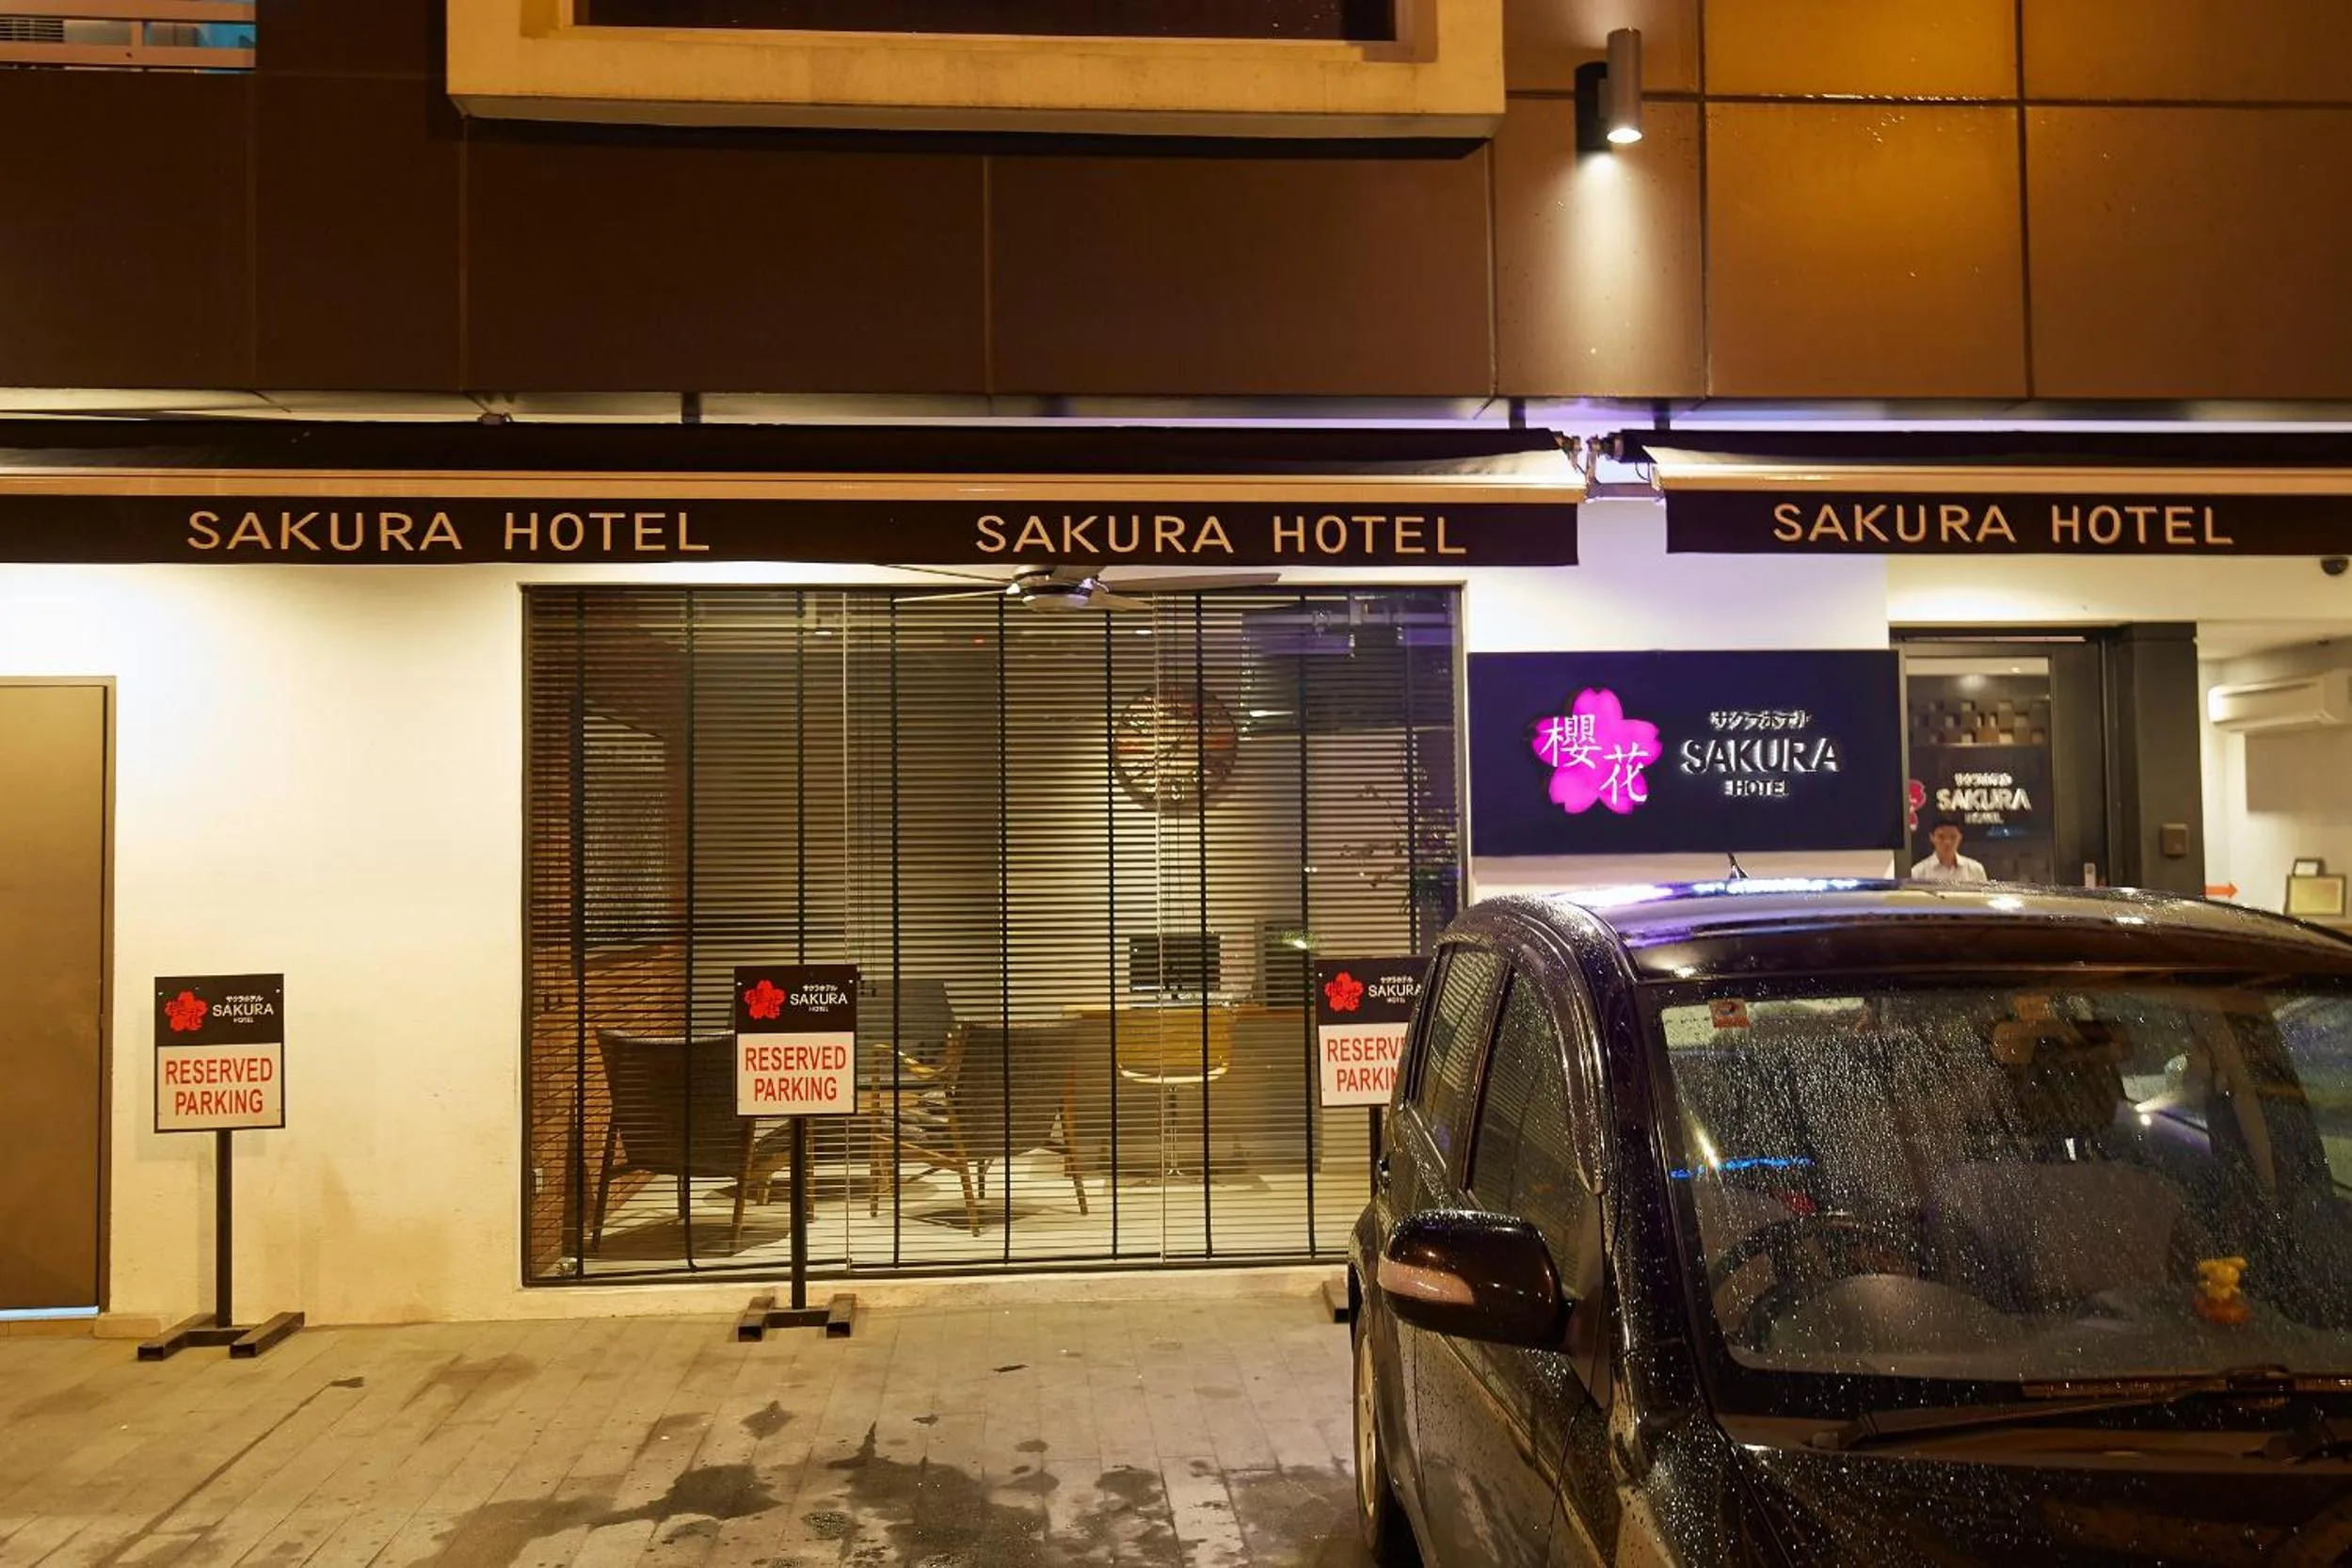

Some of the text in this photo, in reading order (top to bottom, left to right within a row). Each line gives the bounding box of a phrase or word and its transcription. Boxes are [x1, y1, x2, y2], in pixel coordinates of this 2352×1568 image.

[187, 510, 710, 552] SAKURA HOTEL
[975, 514, 1467, 555] SAKURA HOTEL
[1773, 504, 2234, 545] SAKURA HOTEL
[1540, 713, 1649, 805] 櫻花
[1680, 738, 1841, 774] SAKURA
[1725, 779, 1791, 797] HOTEL
[1936, 787, 2033, 811] SAKURA
[212, 1002, 275, 1017] SAKURA
[790, 992, 848, 1006] SAKURA
[744, 1045, 847, 1072] RESERVED
[1326, 1036, 1407, 1063] RESERV
[165, 1057, 273, 1085] RESERVED
[174, 1088, 264, 1116] PARKING
[754, 1076, 837, 1102] PARKING
